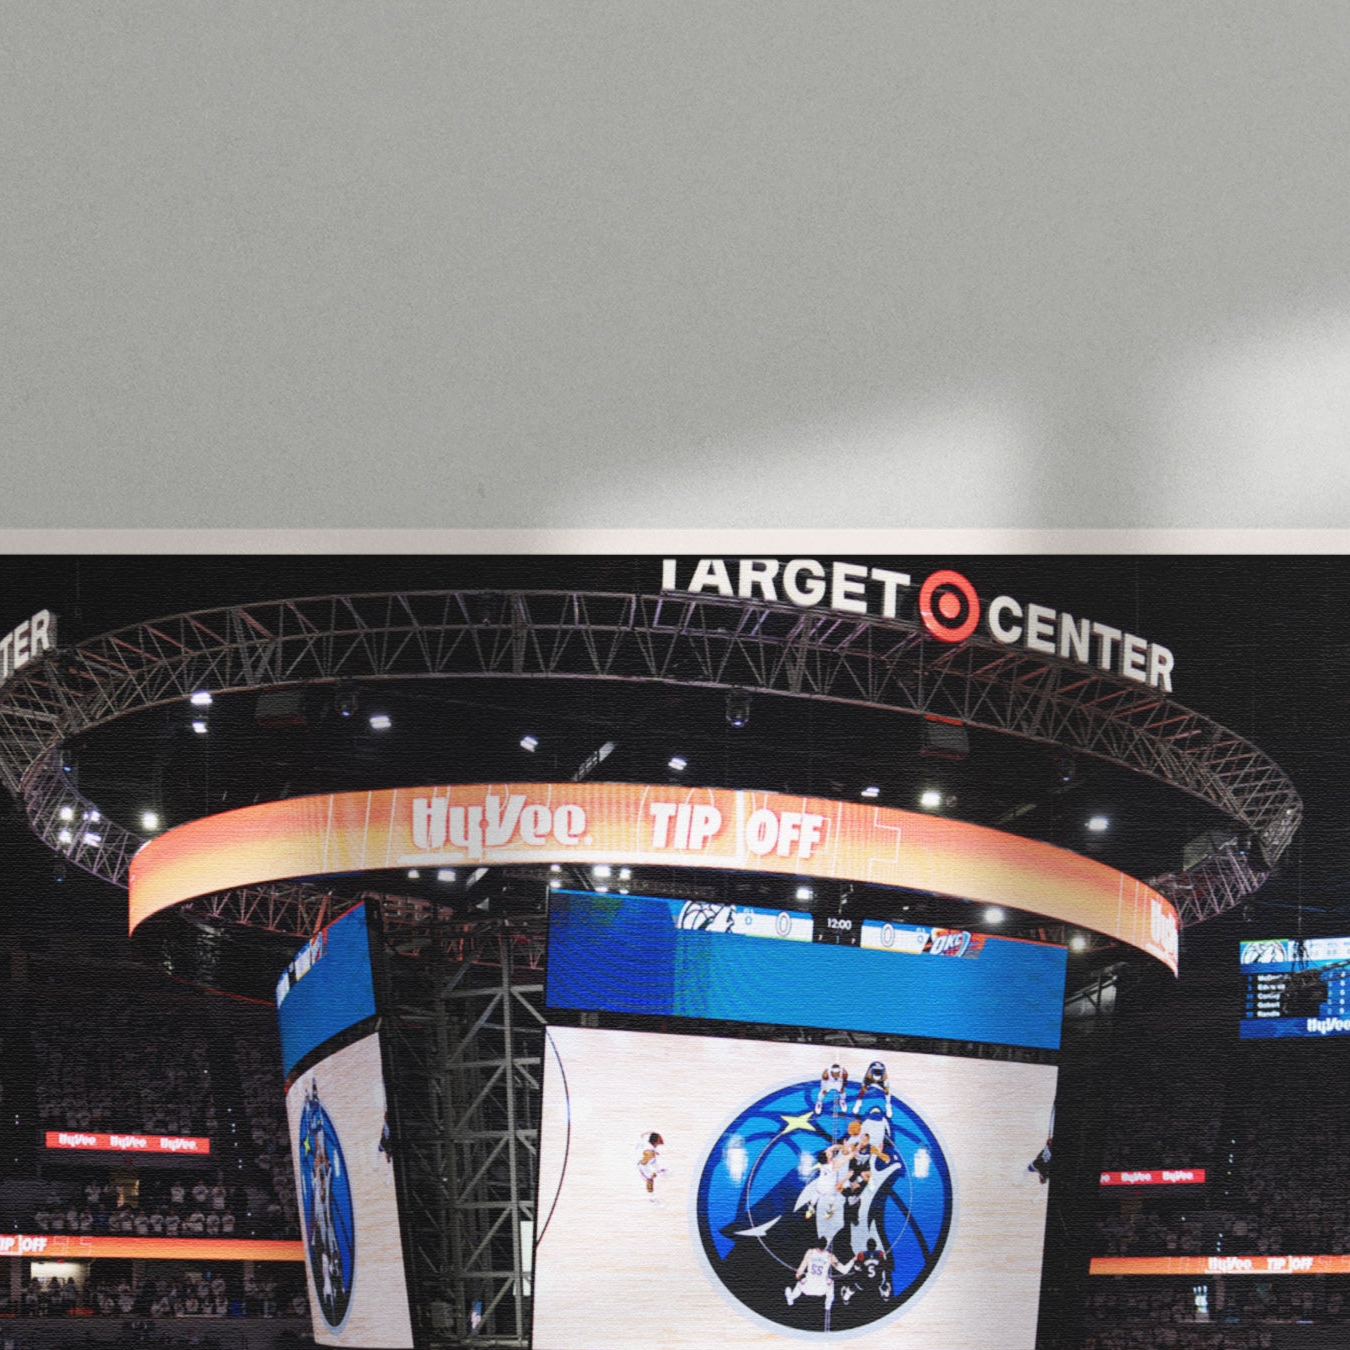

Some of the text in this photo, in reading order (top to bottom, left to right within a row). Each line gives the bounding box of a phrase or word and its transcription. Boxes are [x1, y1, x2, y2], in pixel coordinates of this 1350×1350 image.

[988, 595, 1175, 693] CENTER
[650, 802, 722, 850] TIP
[746, 808, 824, 858] OFF
[776, 911, 792, 936] 0
[827, 917, 852, 931] 12:00
[881, 923, 895, 948] 0
[22, 1237, 48, 1252] OFF
[811, 1263, 824, 1276] 55
[868, 1265, 876, 1278] 5
